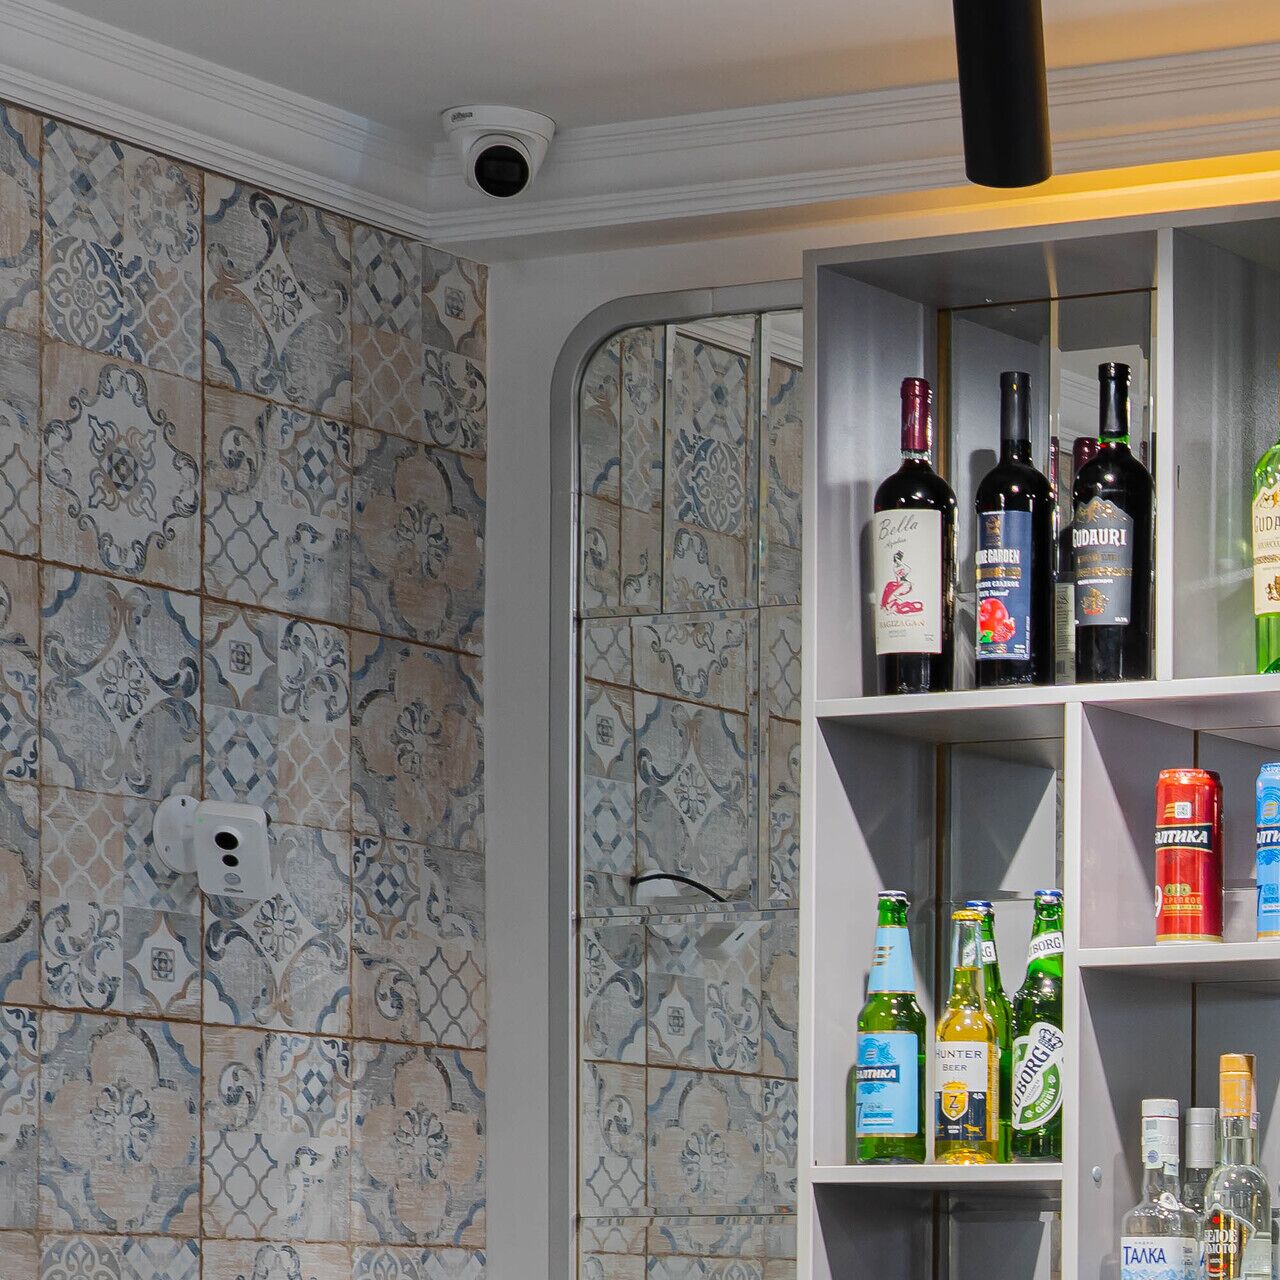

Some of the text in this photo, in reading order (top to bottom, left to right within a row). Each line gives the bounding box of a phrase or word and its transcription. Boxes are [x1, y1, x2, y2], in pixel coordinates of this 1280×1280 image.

[879, 514, 918, 540] Bella
[1073, 528, 1127, 548] GUDAURI
[988, 549, 1020, 564] GARDEN
[1155, 830, 1208, 845] АЛТИКА
[1028, 937, 1061, 958] BORG
[942, 1063, 968, 1072] BEER
[1013, 1046, 1050, 1117] UBORG
[949, 1095, 959, 1109] Z
[1123, 1246, 1167, 1266] ТАЛКА
[1206, 1243, 1237, 1254] ЛОТО
